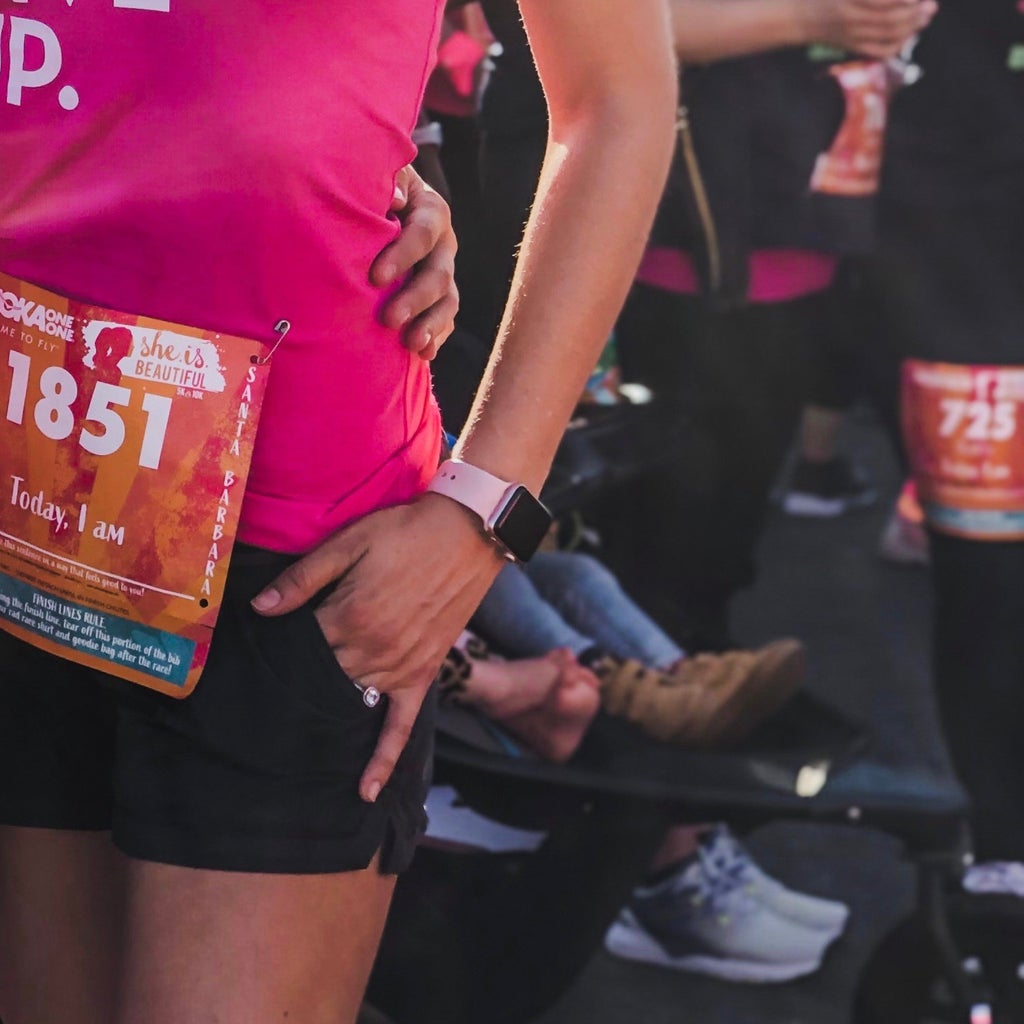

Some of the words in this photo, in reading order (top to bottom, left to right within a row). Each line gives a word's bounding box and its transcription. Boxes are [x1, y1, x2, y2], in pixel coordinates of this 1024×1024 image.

[20, 331, 33, 344] TO
[45, 308, 74, 328] ONE
[45, 322, 75, 343] ONE
[135, 359, 206, 389] BEAUTIFUL
[5, 349, 173, 470] 1851
[229, 366, 256, 457] SANTA
[938, 399, 1016, 441] 725
[11, 475, 70, 533] Today,
[78, 503, 87, 533] I
[201, 470, 234, 596] BARBARA
[70, 566, 84, 578] that
[120, 582, 128, 592] to
[32, 593, 57, 612] FINISH
[58, 604, 82, 621] LINES
[12, 597, 23, 610] the
[23, 602, 44, 619] finish
[63, 619, 79, 632] tear
[81, 625, 95, 636] off
[95, 629, 111, 642] this
[112, 636, 142, 651] portion
[143, 645, 152, 656] of
[153, 648, 167, 661] the
[167, 652, 181, 666] bib
[37, 621, 54, 635] shirt
[55, 629, 71, 641] and
[72, 635, 100, 651] goodie
[101, 643, 116, 659] bag
[117, 649, 137, 663] after
[138, 656, 152, 669] the
[152, 663, 173, 675] race!
